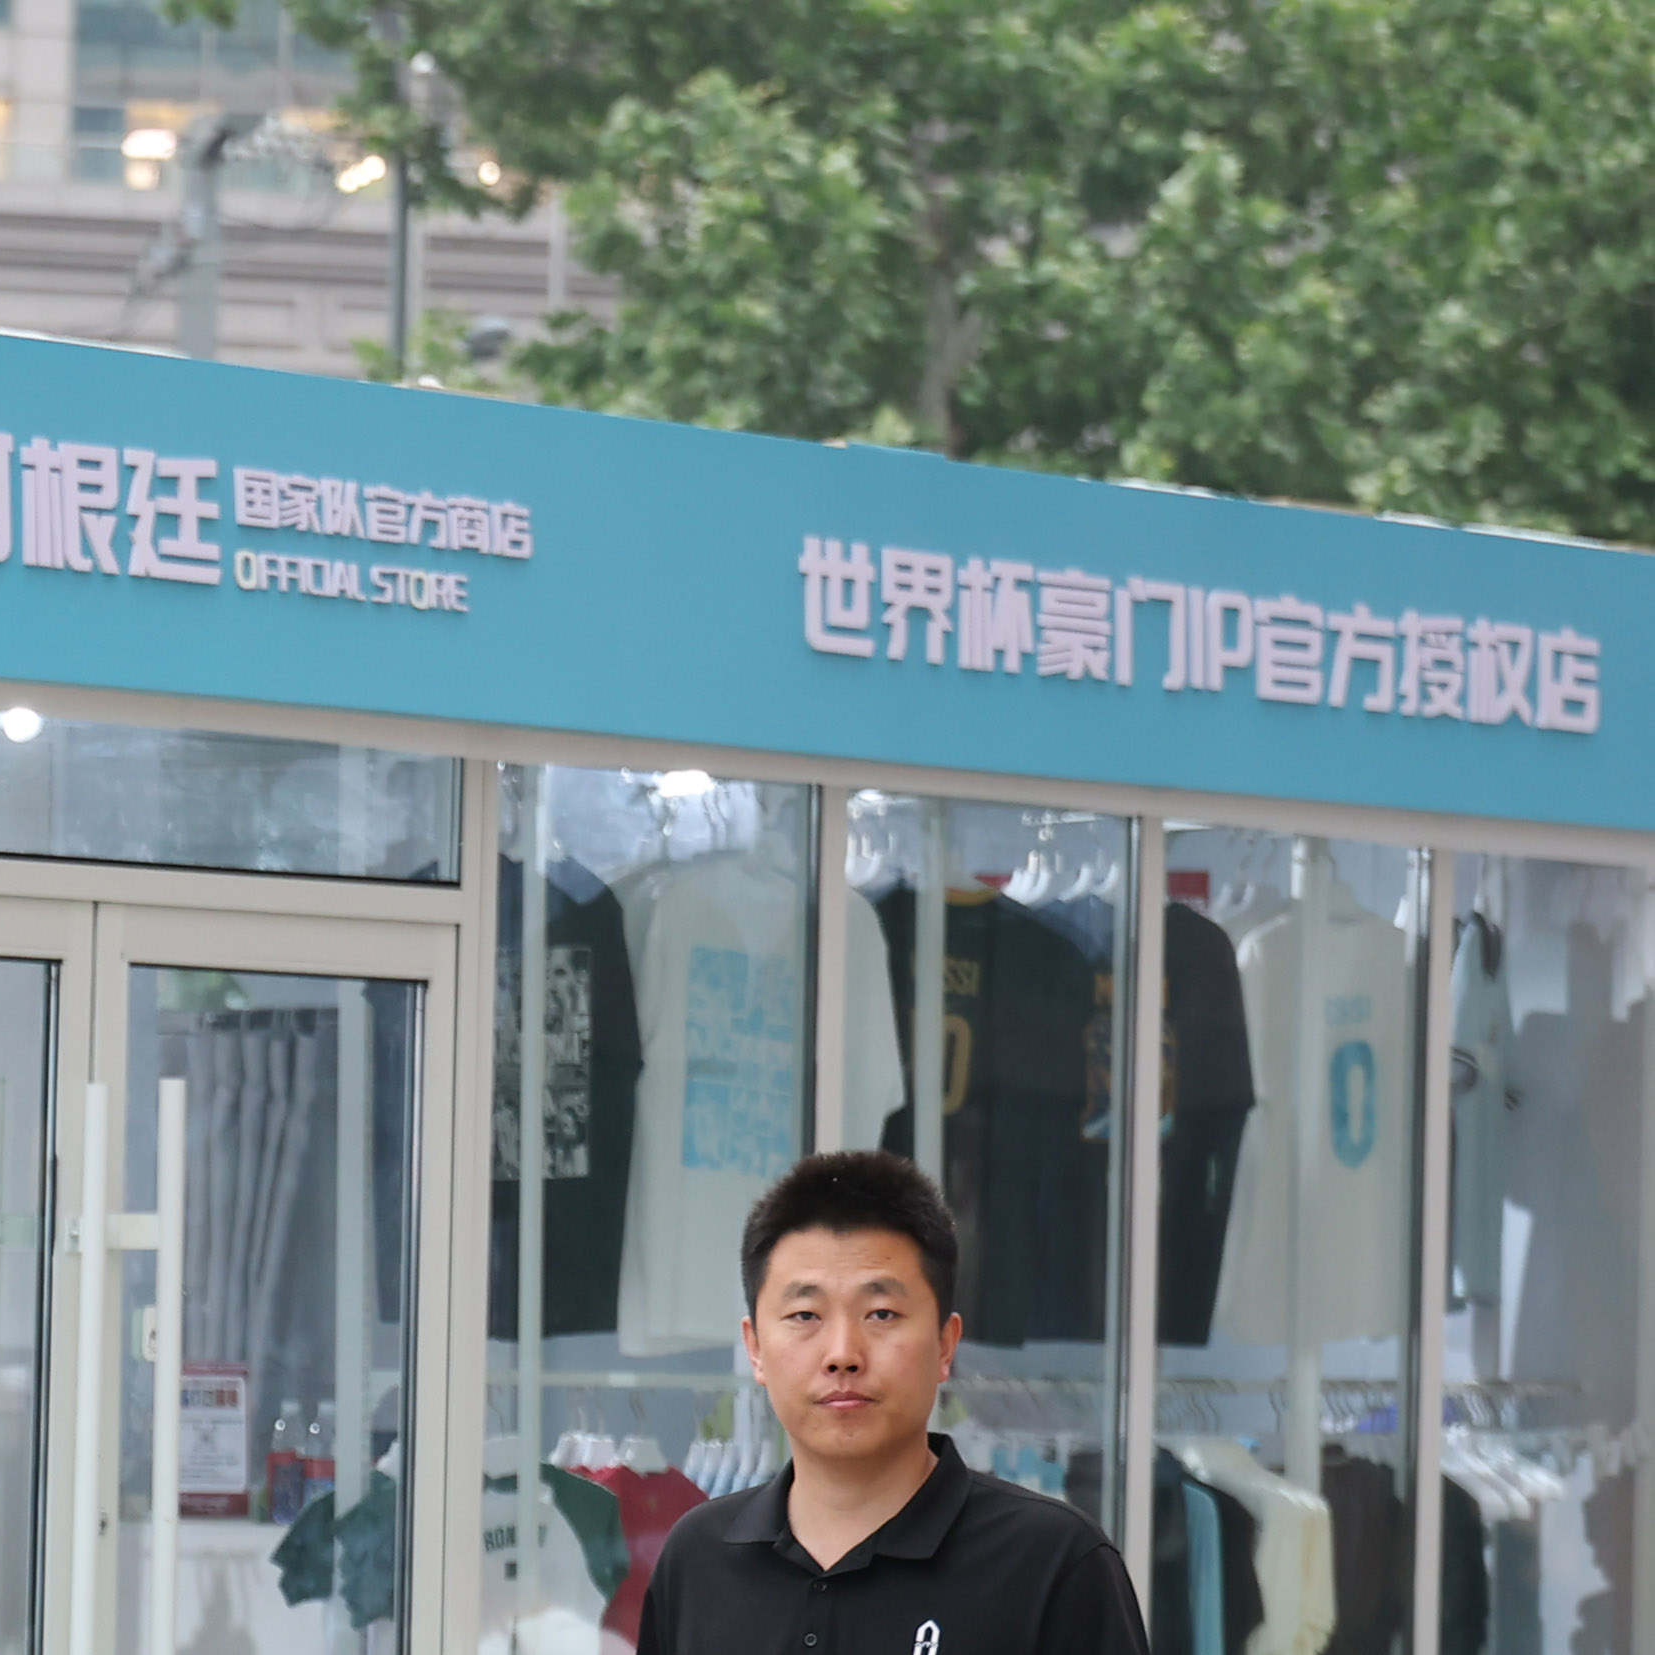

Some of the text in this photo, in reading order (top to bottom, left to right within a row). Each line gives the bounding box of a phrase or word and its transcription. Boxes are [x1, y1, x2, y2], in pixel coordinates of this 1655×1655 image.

[234, 467, 534, 560] 国家队官方商店
[235, 548, 469, 613] OFFICIAL STORE
[797, 534, 1601, 735] 世界杯豪门IP官方授权店
